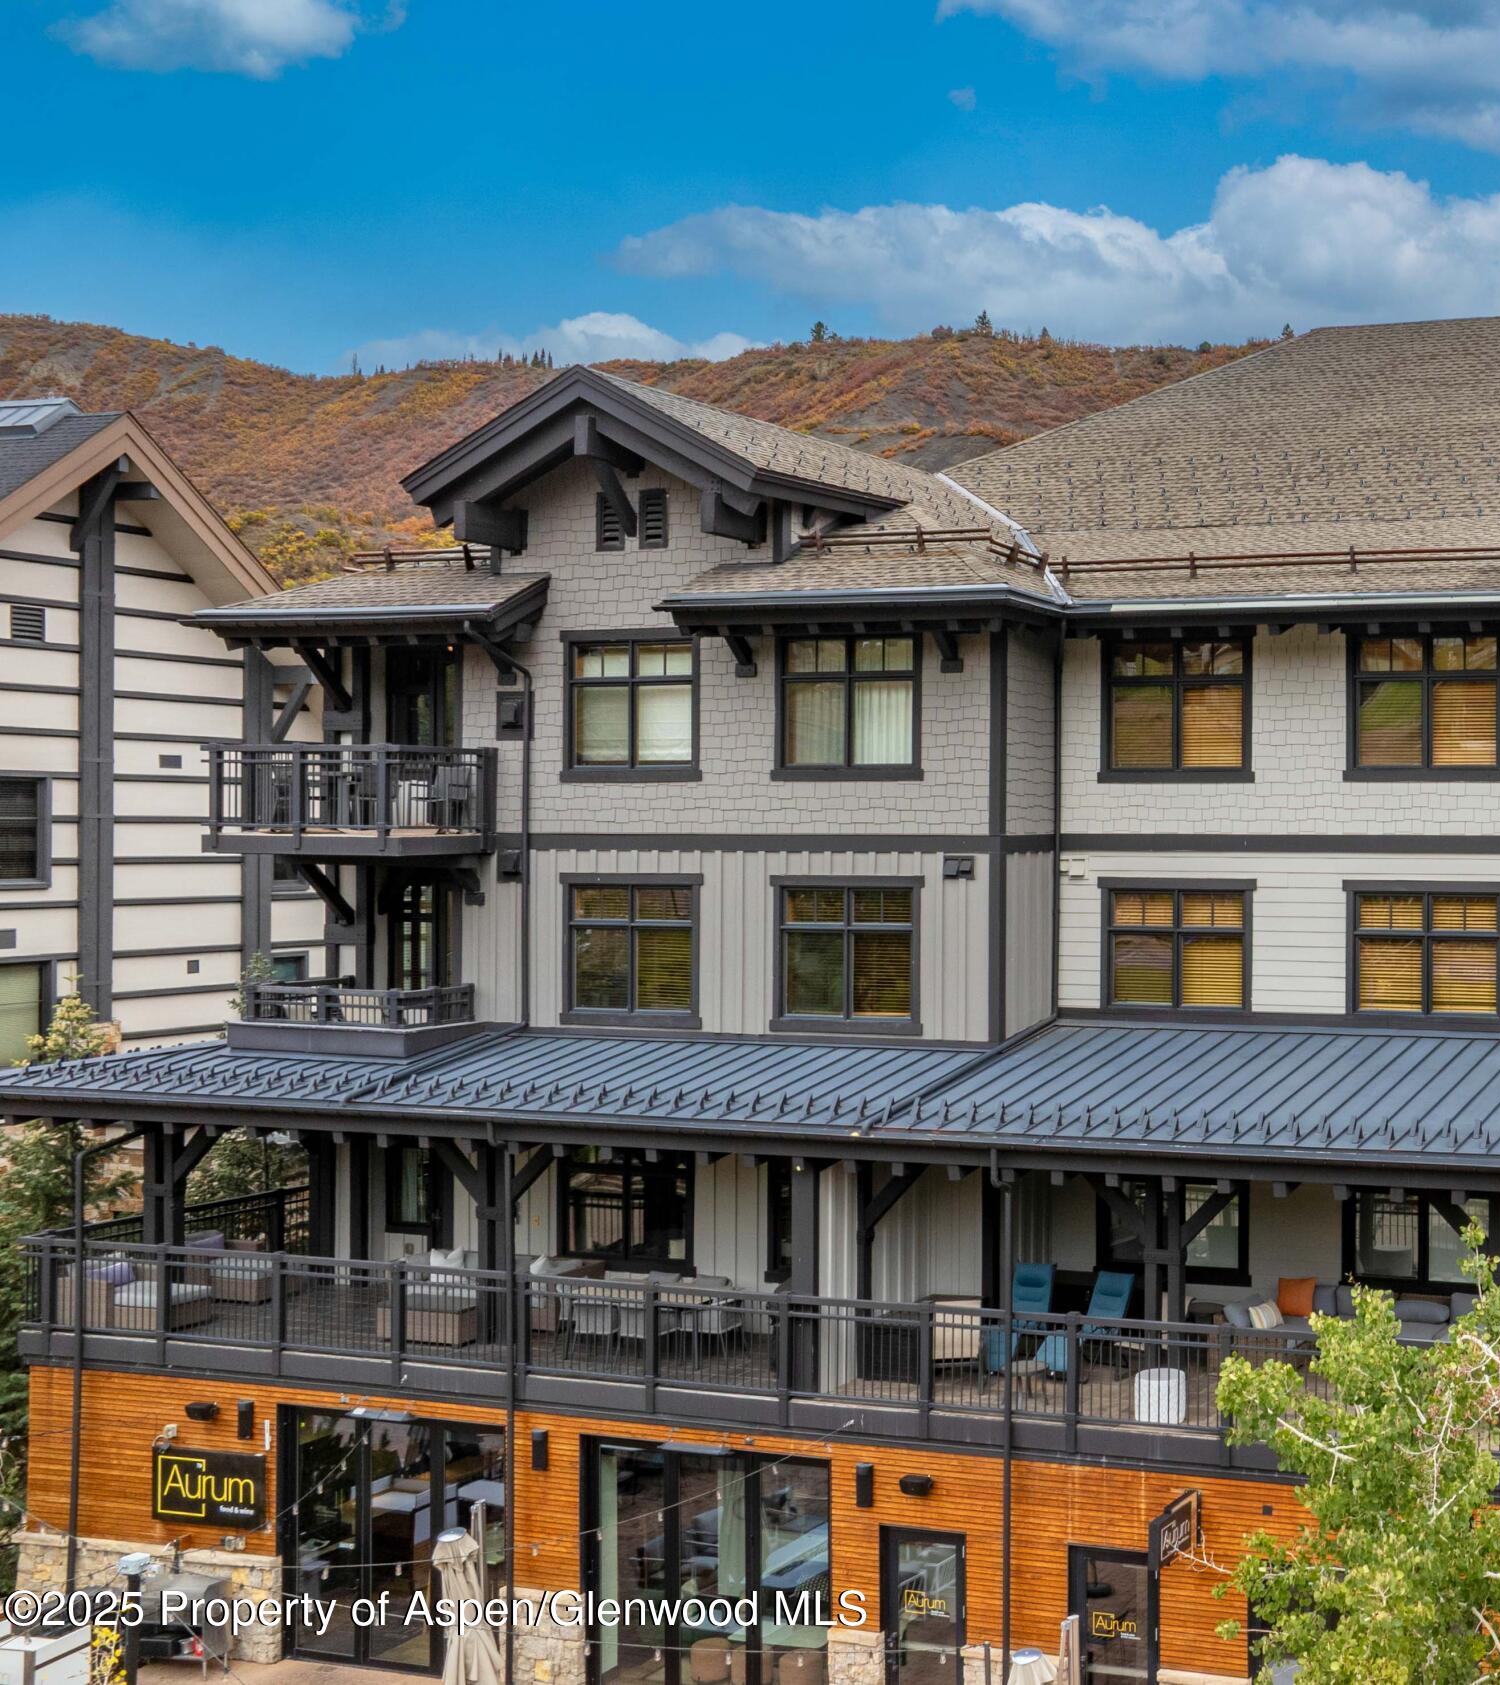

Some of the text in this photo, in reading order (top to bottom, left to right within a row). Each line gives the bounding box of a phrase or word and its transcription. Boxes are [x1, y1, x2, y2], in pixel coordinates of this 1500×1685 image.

[163, 1464, 255, 1505] Aurum
[908, 1593, 946, 1611] Aurum
[1096, 1615, 1137, 1633] Aurum
